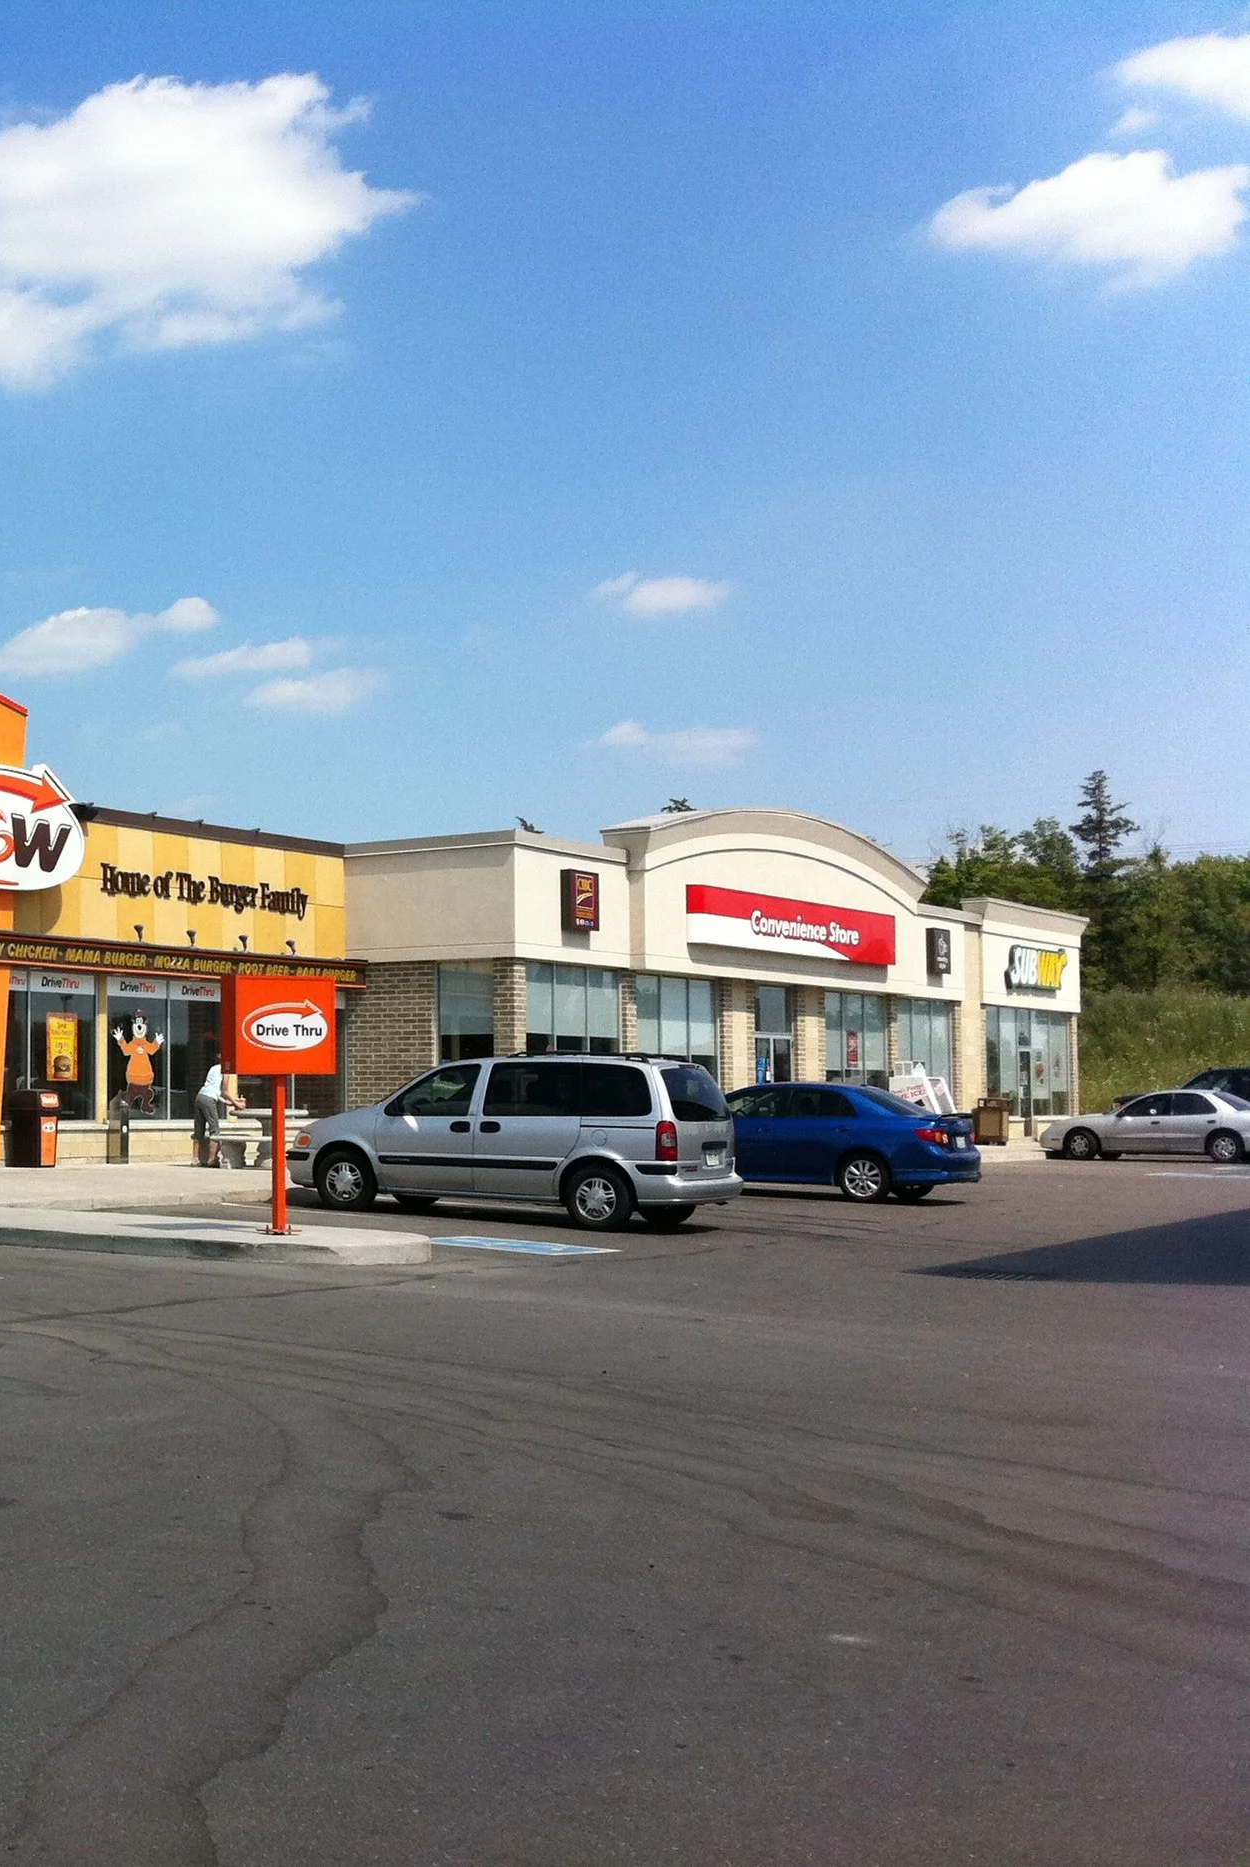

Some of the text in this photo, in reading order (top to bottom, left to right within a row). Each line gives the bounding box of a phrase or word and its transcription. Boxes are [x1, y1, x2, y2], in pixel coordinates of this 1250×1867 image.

[100, 862, 310, 921] Home of The Burger Family
[751, 909, 860, 946] Convenience Store
[7, 943, 59, 960] CHICKEN
[66, 948, 101, 964] MAMA
[104, 951, 148, 968] BURGER
[153, 955, 191, 970] MOZZA
[193, 958, 232, 974] BURGER
[238, 962, 265, 975] ROOT
[1009, 946, 1068, 988] SUBWAY
[256, 1024, 323, 1037] Drive Thru
